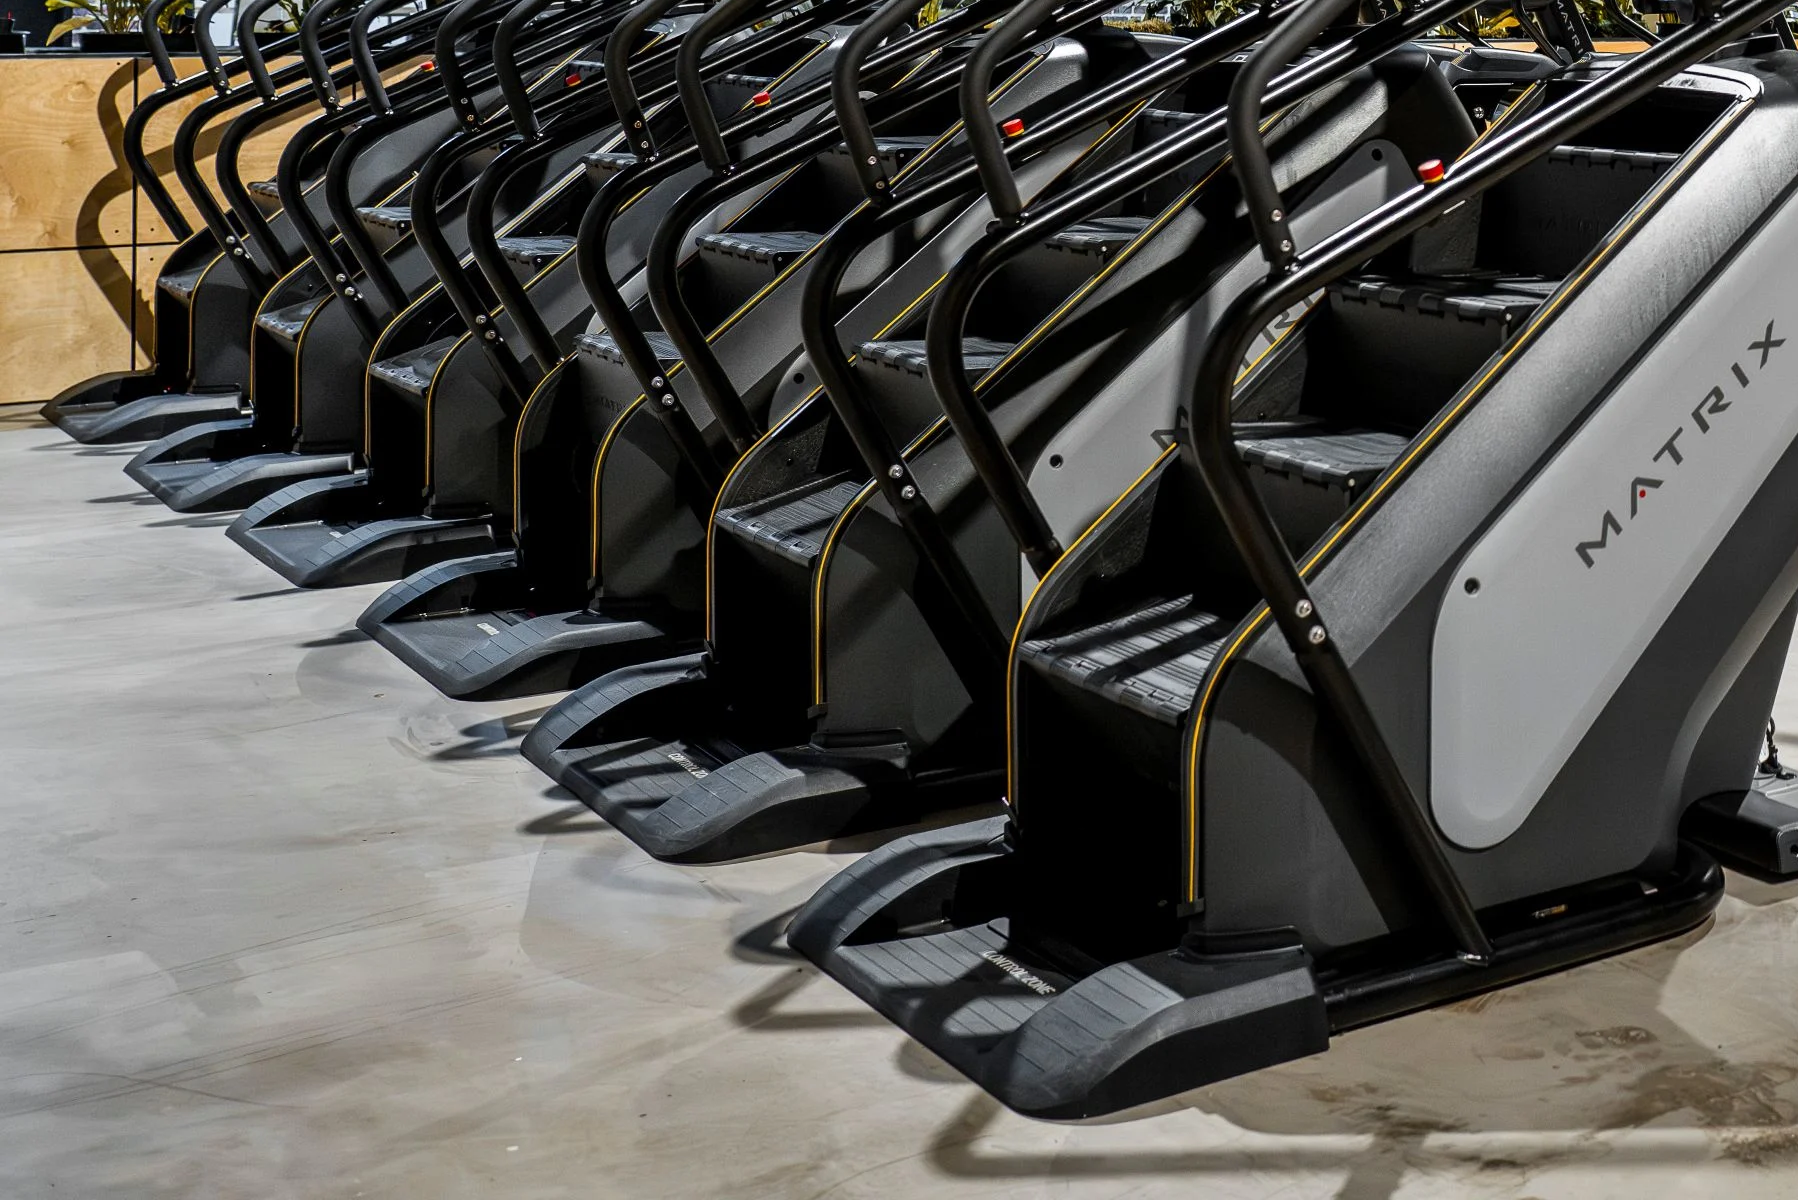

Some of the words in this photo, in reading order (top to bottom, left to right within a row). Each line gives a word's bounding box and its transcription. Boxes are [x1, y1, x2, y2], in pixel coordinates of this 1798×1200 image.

[1575, 319, 1786, 569] MATRIX
[982, 950, 1029, 979] CONTROL
[1021, 975, 1056, 995] ZONE
